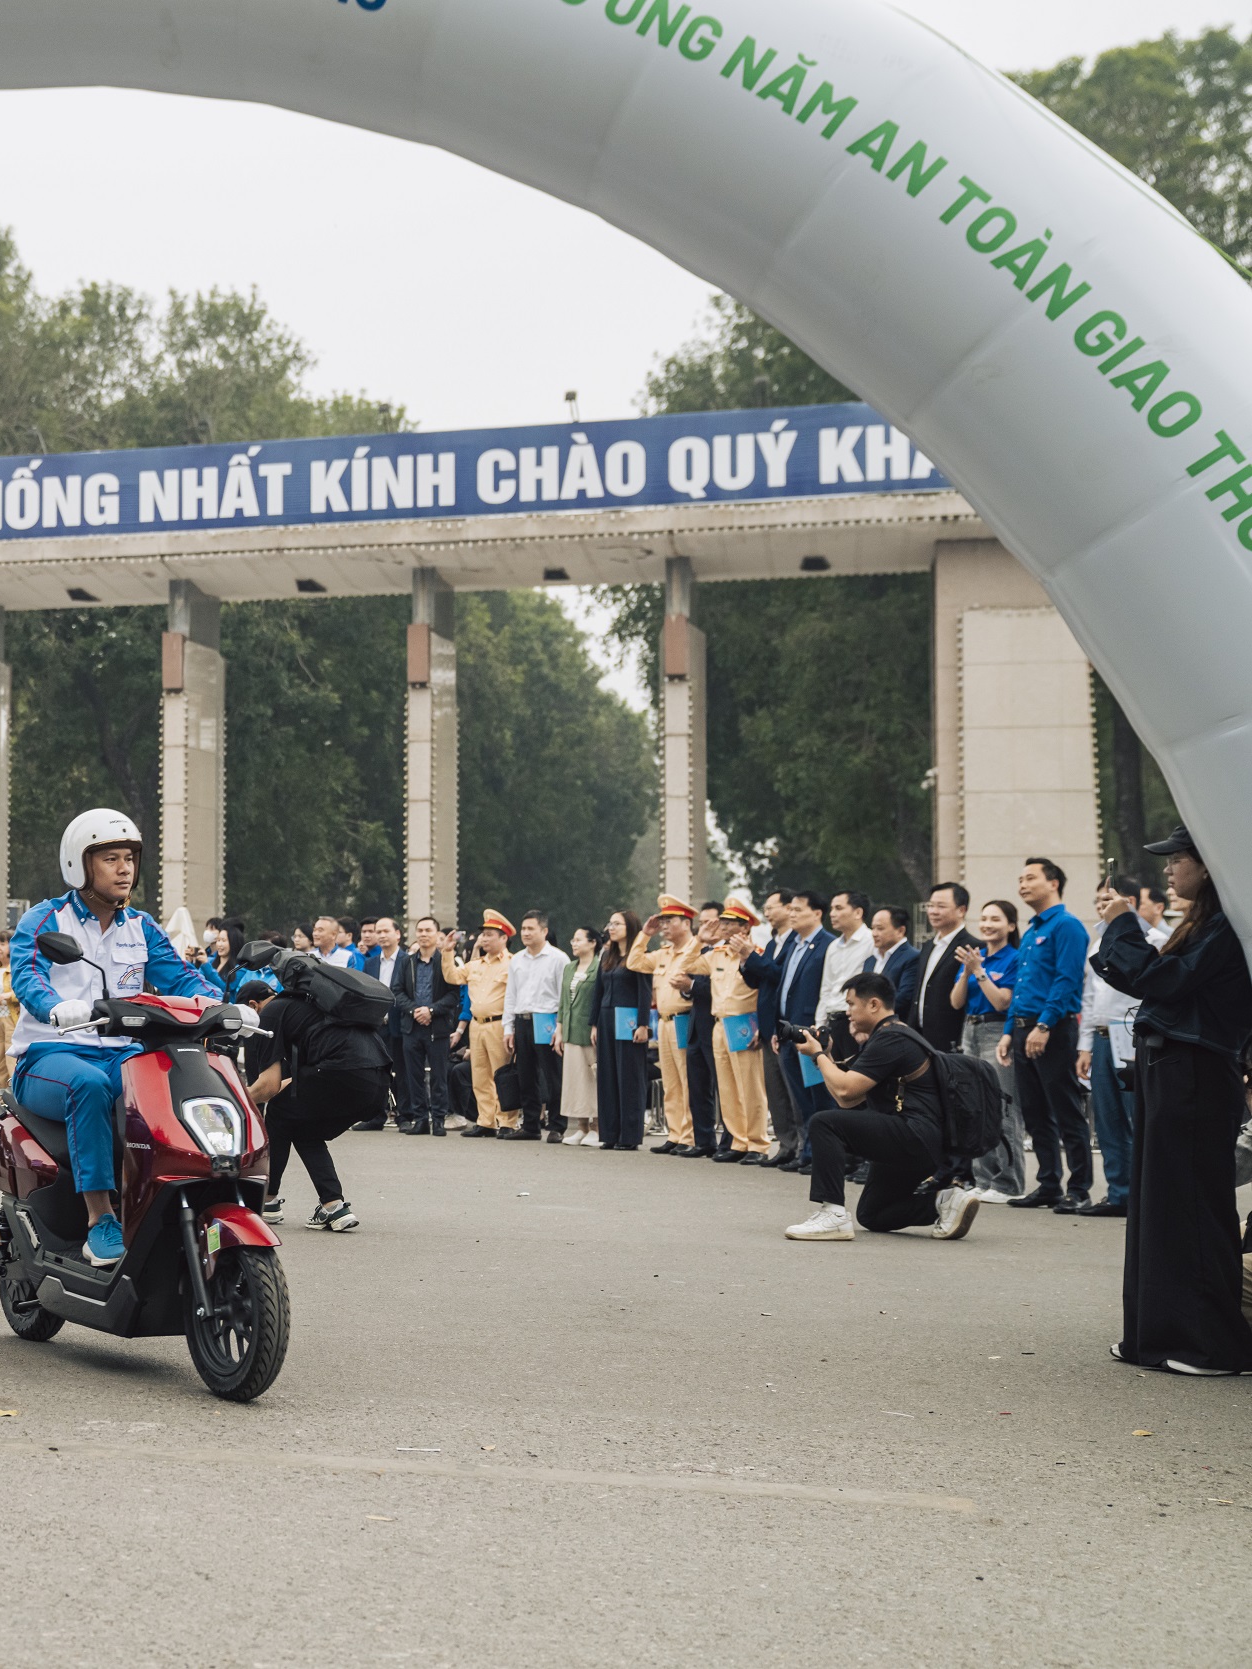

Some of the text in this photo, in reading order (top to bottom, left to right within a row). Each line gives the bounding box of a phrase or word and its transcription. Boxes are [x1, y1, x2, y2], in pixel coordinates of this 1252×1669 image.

[719, 34, 859, 141] NĂM
[845, 119, 949, 198] AN
[938, 175, 1092, 322] TOÀN
[1073, 310, 1203, 438] GIAO
[139, 445, 292, 523] NHẤT
[310, 445, 456, 514] KÍNH
[476, 433, 647, 505] CHÀO
[667, 418, 798, 500] QUÝ
[126, 1142, 151, 1150] HONDA
